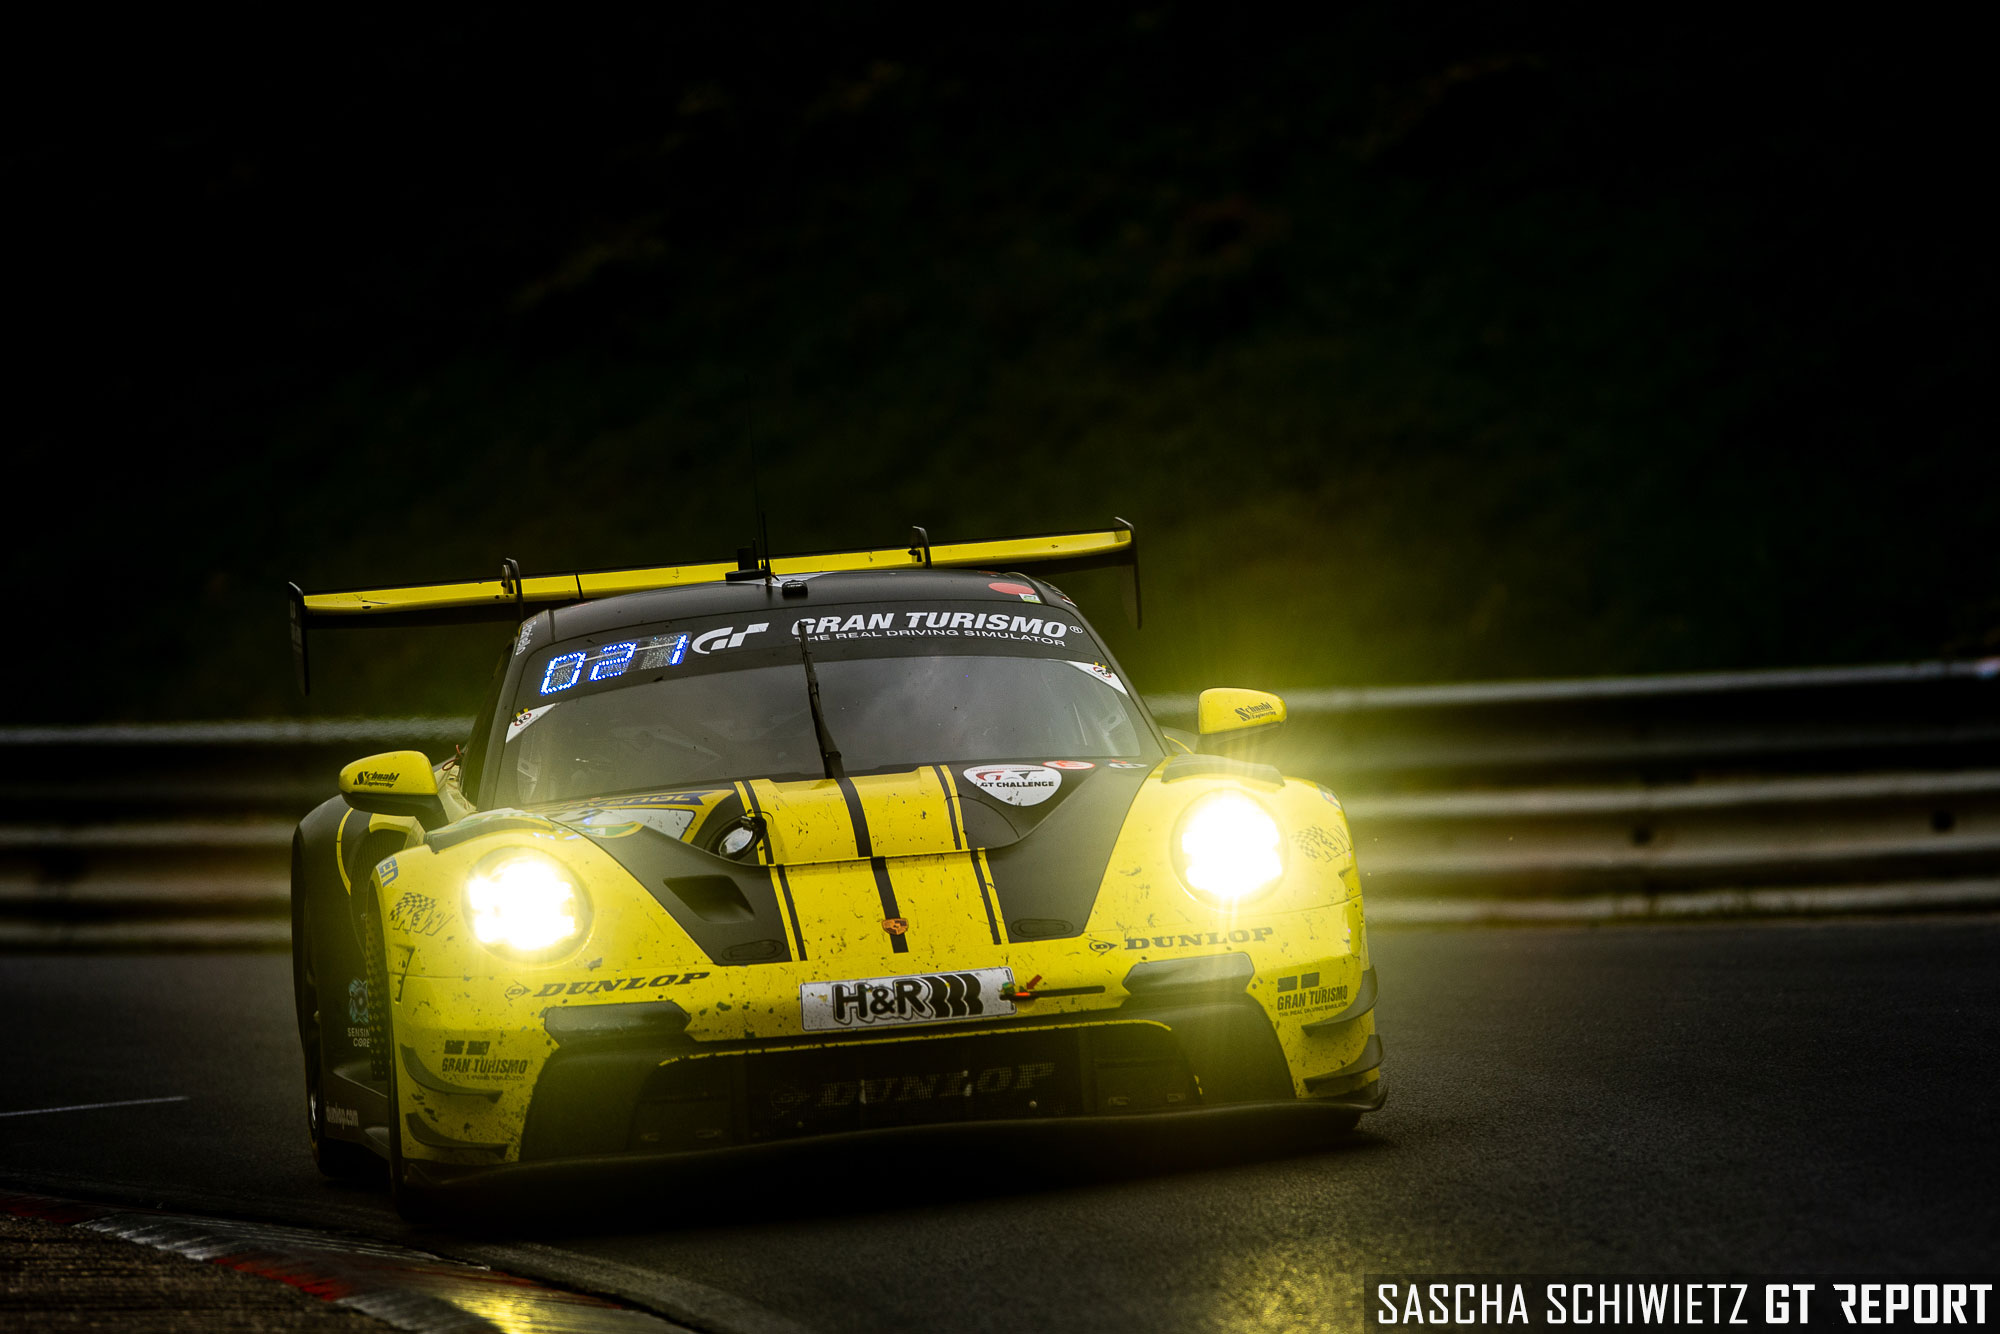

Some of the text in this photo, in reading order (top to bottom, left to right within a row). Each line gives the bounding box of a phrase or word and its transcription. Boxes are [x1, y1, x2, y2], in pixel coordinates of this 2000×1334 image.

[791, 612, 1067, 638] GRAN TURISMO
[835, 631, 882, 640] REAL
[888, 629, 960, 637] DRIVING
[964, 629, 1066, 647] SIMULATOR
[540, 633, 691, 697] 021
[1124, 927, 1274, 950] DUNLOP
[532, 971, 711, 998] DUNLOP
[1277, 984, 1348, 1011] GRAN TURISMO
[833, 978, 933, 1025] H&R
[442, 1058, 528, 1074] GRAN TURISMO
